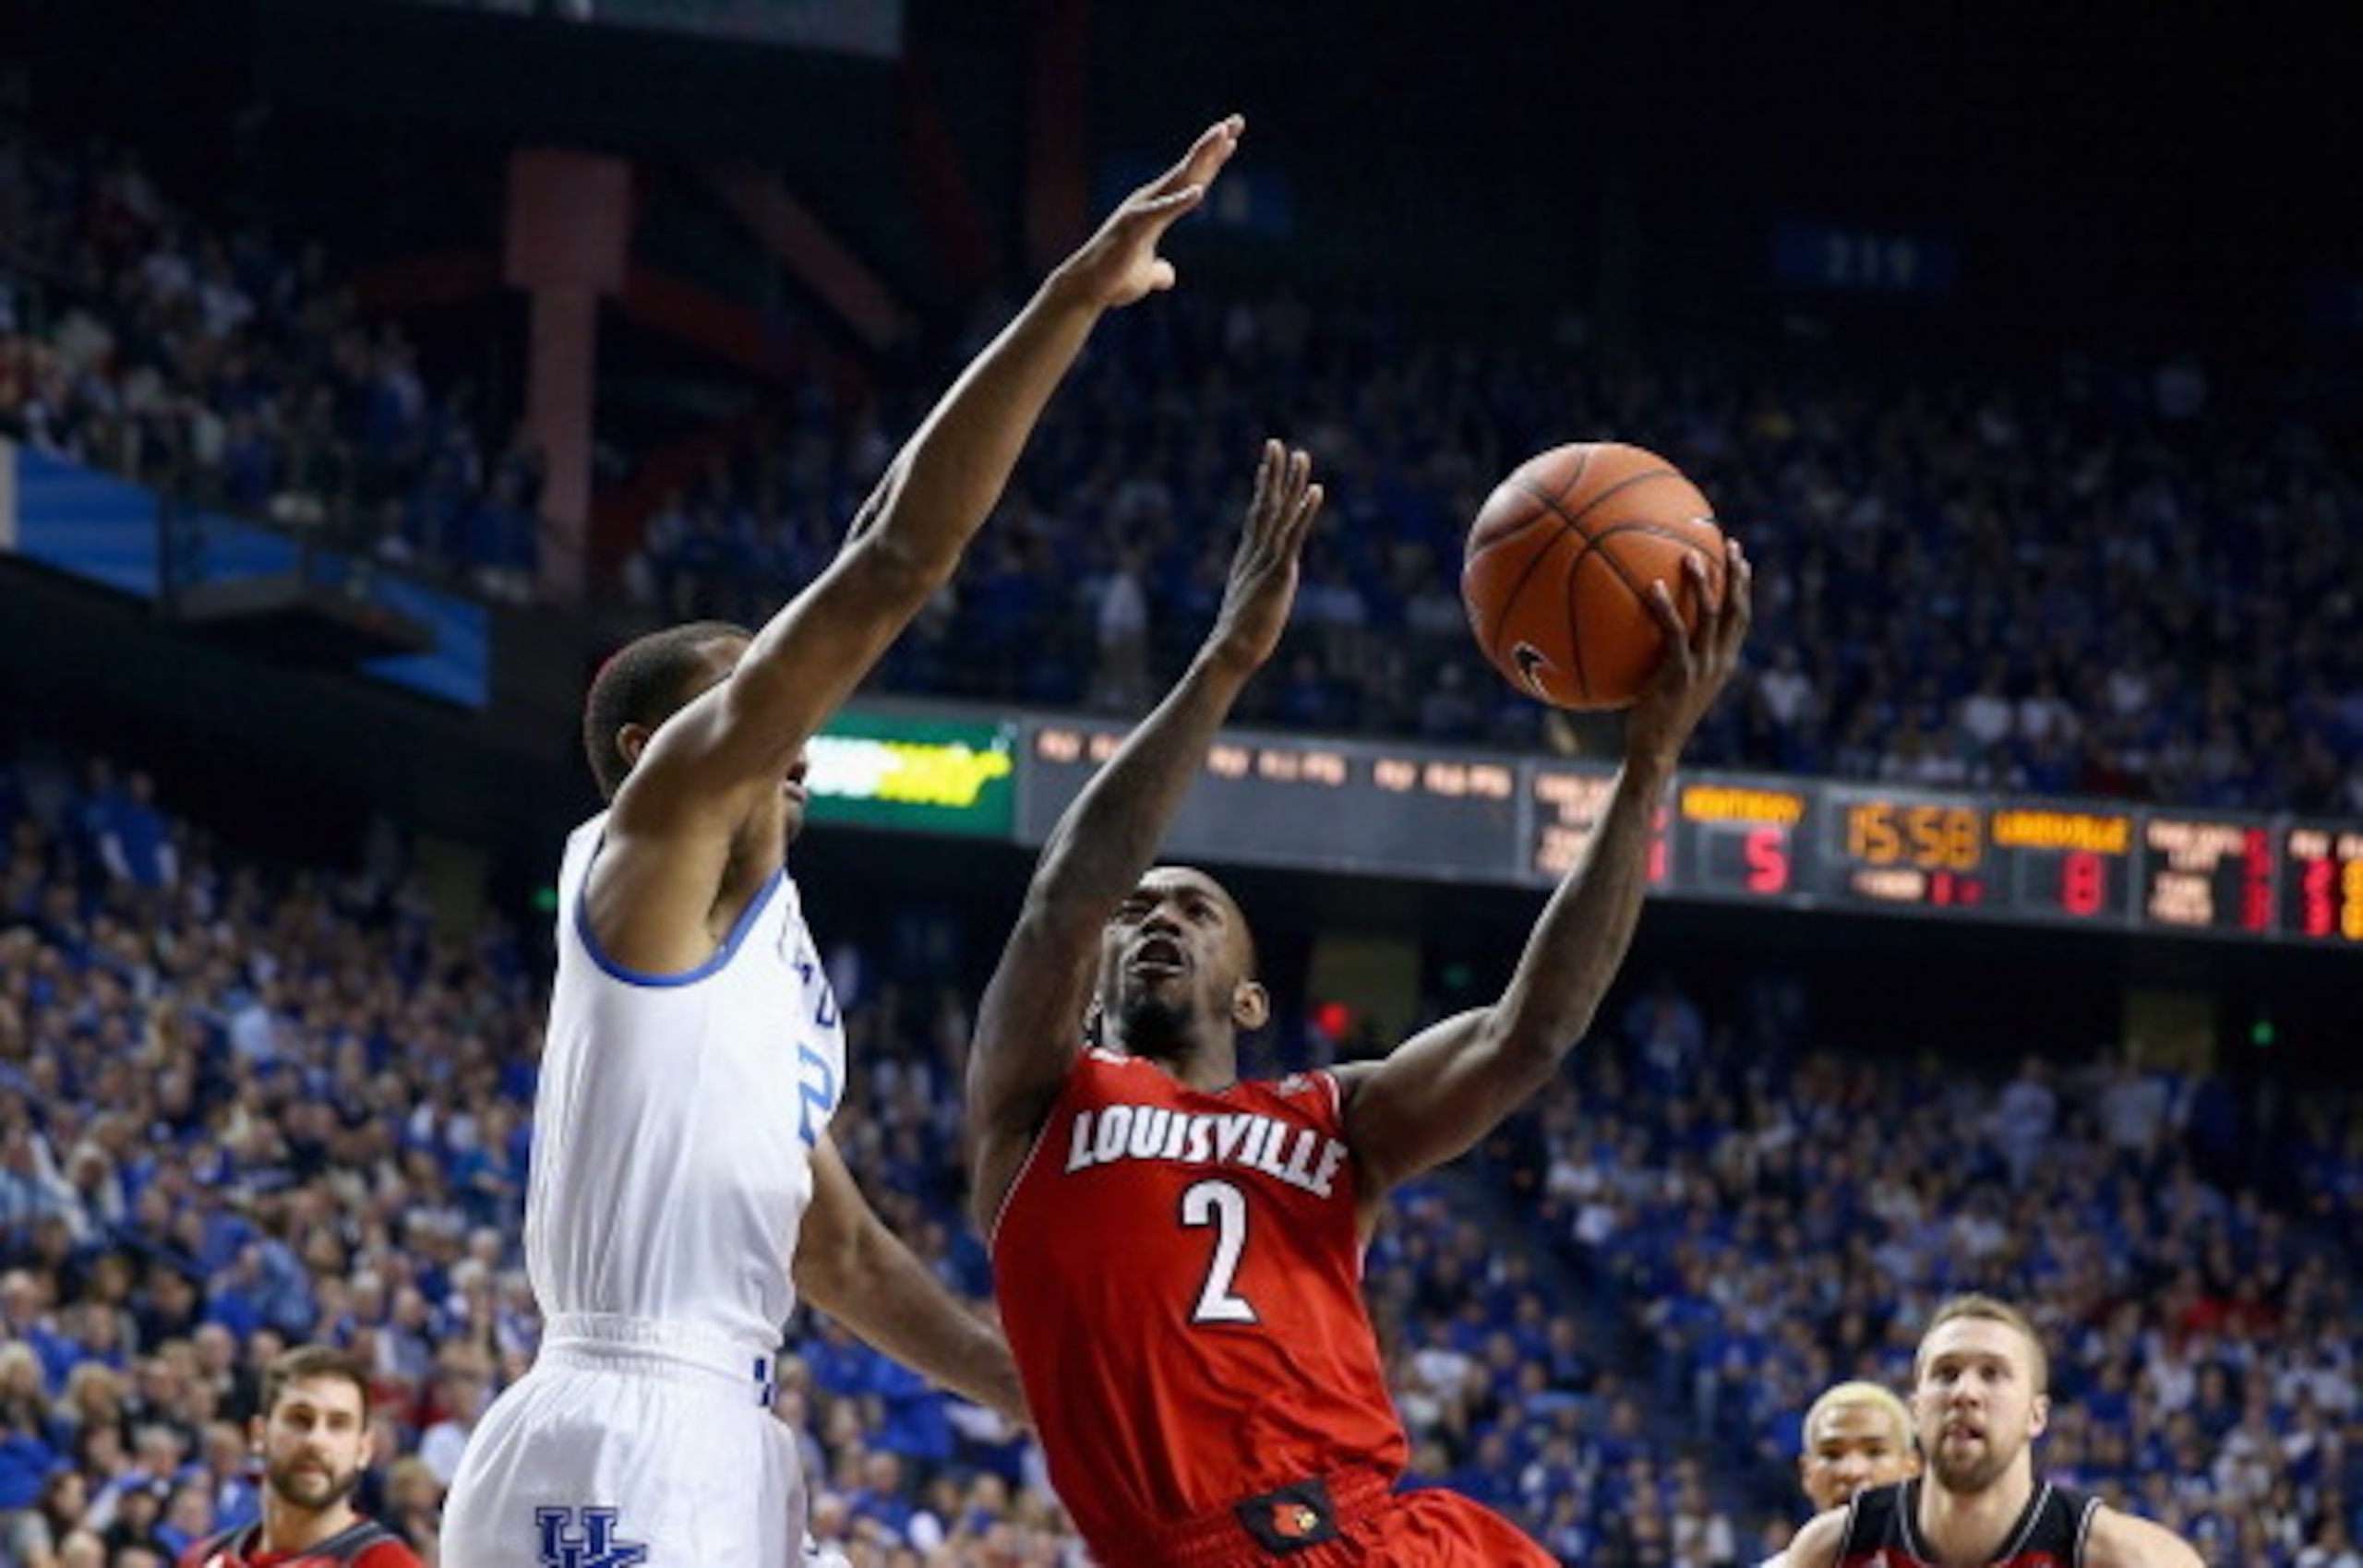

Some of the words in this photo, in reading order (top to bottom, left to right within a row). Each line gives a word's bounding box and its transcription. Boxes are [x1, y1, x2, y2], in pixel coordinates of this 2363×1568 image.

[1745, 827, 1789, 893] 5
[1064, 1103, 1349, 1200] LOUISVILLE
[1181, 1178, 1260, 1325] 2
